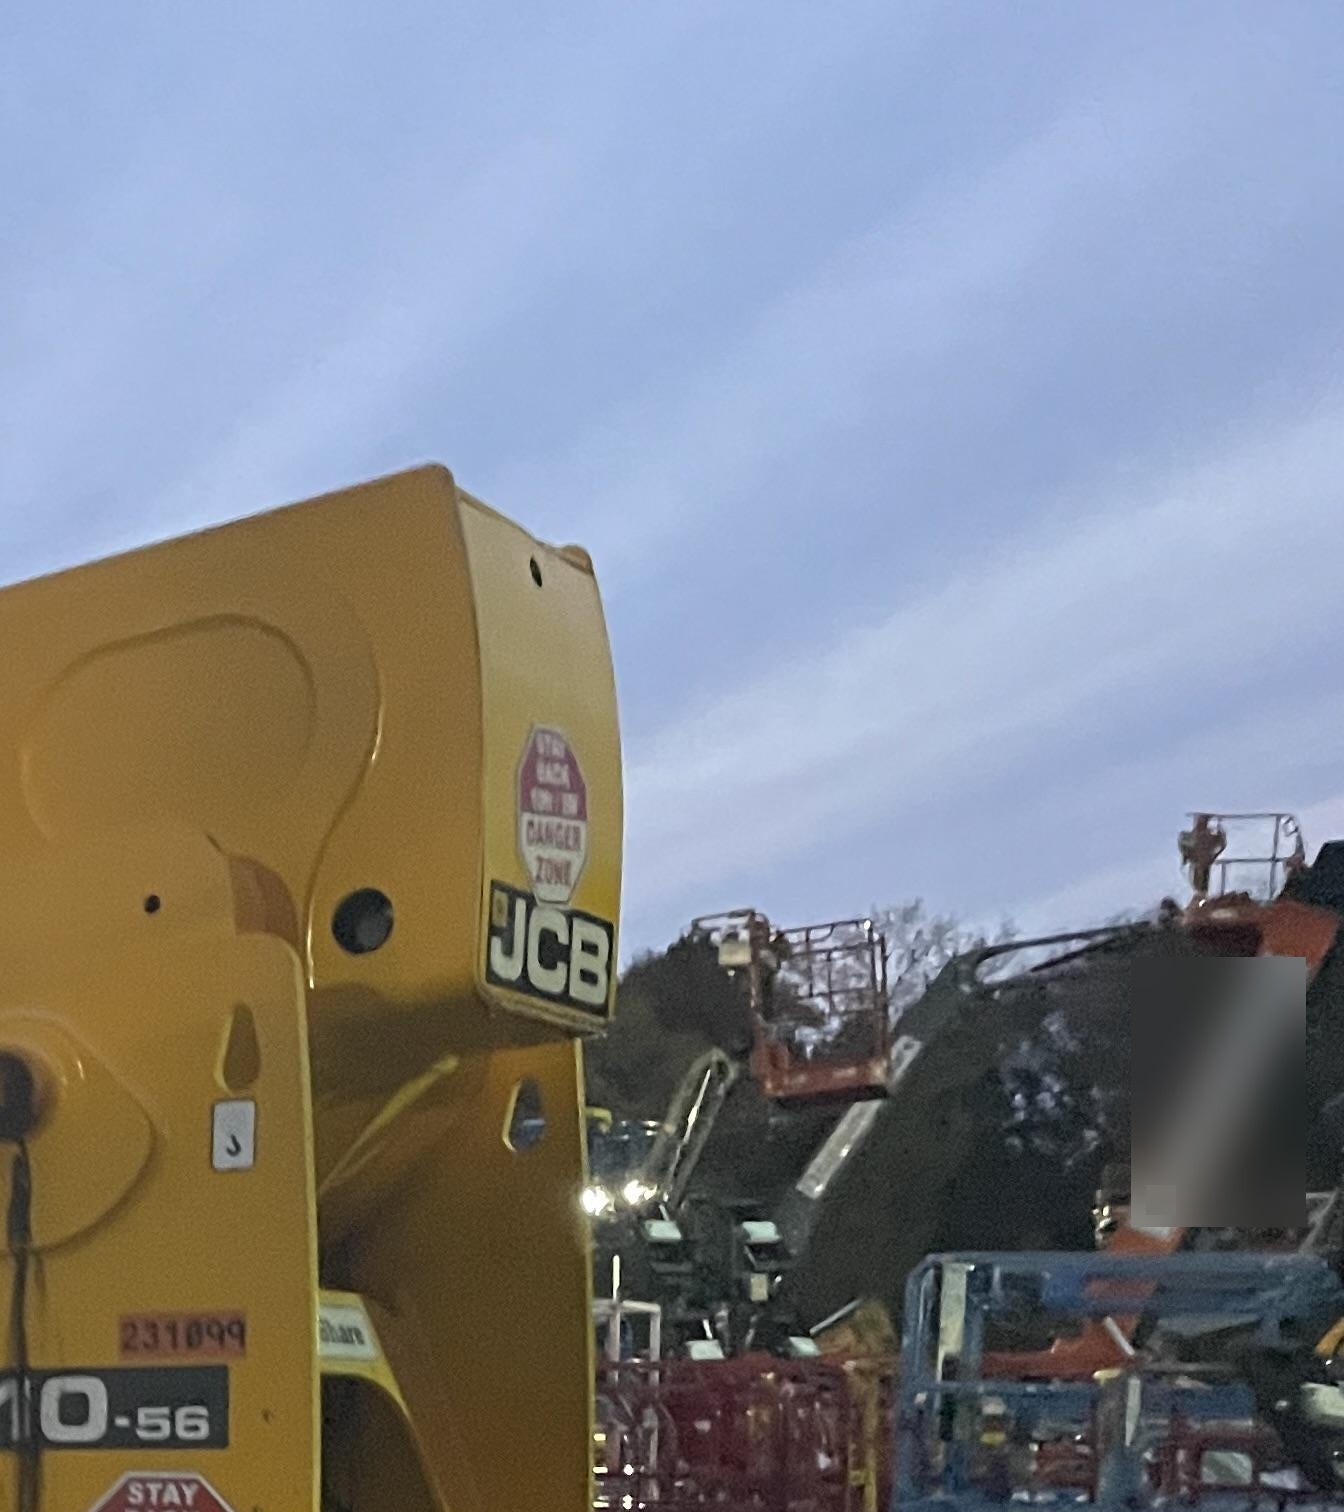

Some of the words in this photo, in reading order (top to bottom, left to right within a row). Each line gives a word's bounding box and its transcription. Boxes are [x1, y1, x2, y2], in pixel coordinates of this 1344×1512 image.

[525, 819, 582, 853] DANGER
[535, 856, 573, 887] ZONE
[490, 898, 610, 1005] JCB
[127, 1481, 200, 1506] STAY
